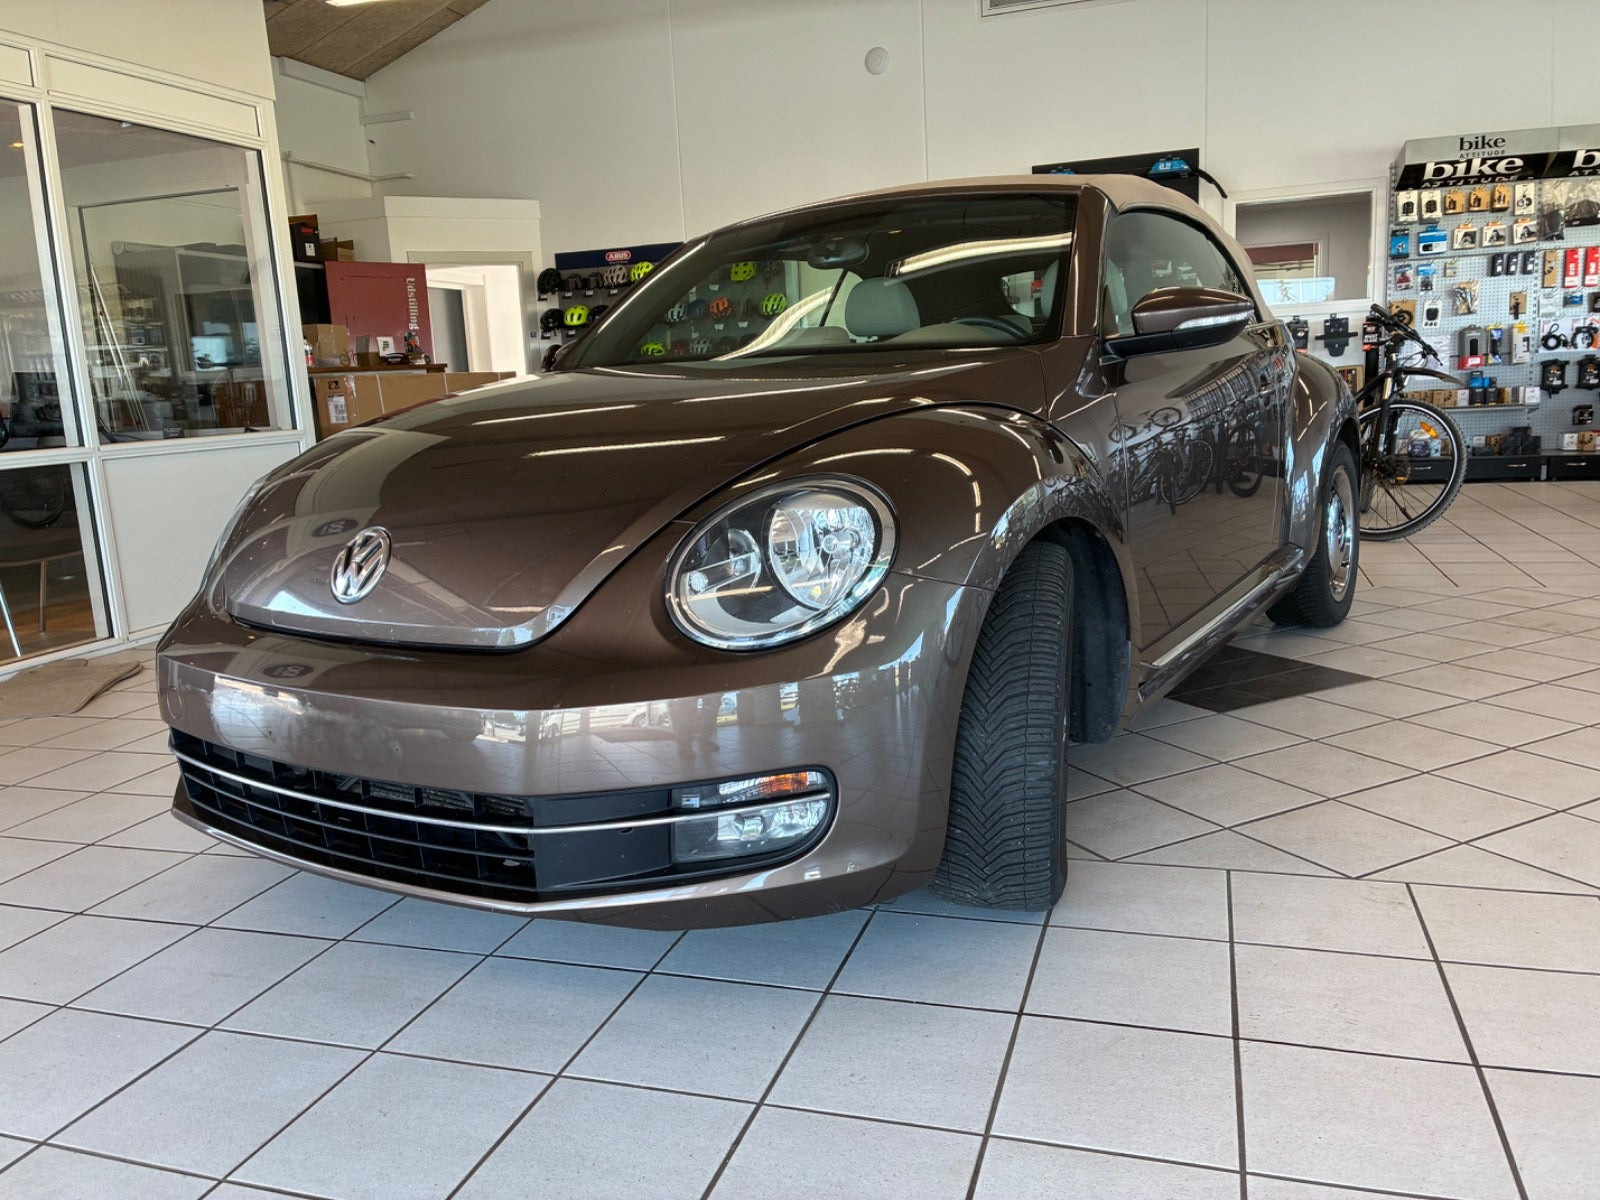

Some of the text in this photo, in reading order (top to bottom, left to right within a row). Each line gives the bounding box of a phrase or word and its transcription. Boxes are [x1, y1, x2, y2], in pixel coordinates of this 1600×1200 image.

[1459, 135, 1506, 151] bike
[1459, 150, 1506, 159] ATTITUDE
[1423, 157, 1524, 180] bike
[406, 277, 420, 330] Udstilling
